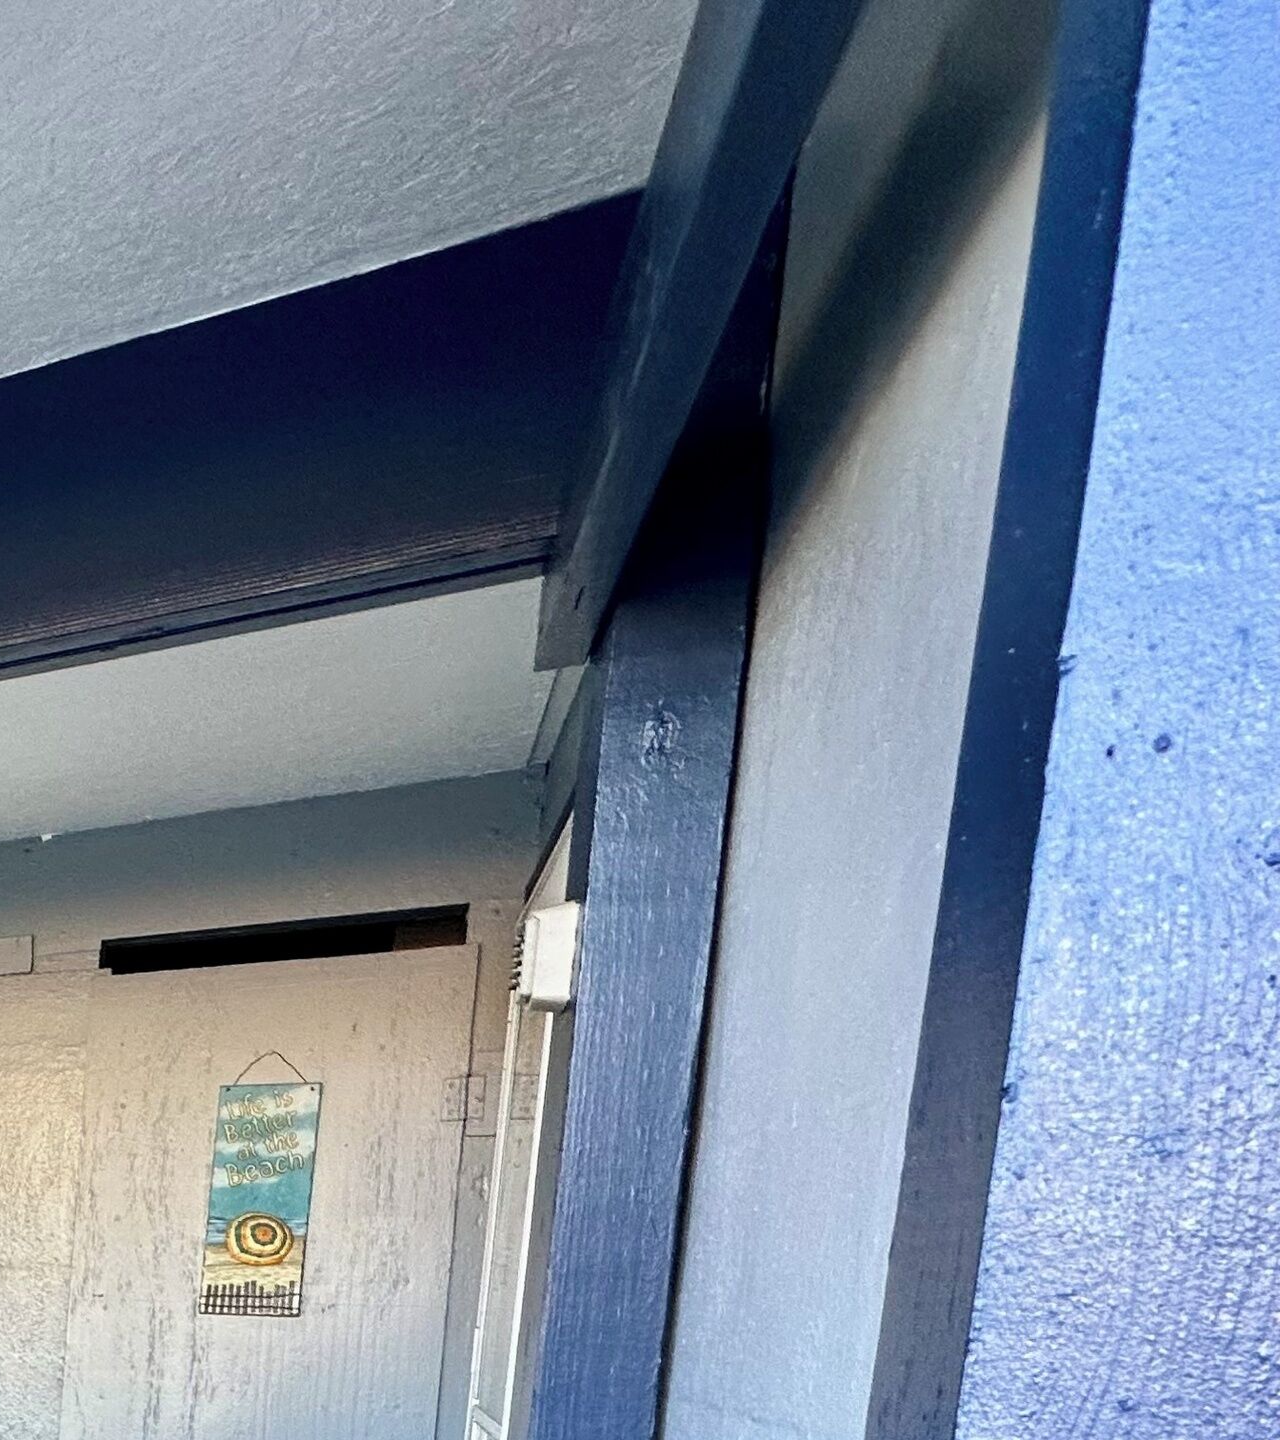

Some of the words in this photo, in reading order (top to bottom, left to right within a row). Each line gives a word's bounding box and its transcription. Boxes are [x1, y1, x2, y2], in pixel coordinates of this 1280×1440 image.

[272, 1087, 295, 1108] is
[223, 1109, 298, 1144] Better
[238, 1140, 257, 1161] at
[264, 1130, 300, 1154] the
[224, 1150, 304, 1188] Beach
